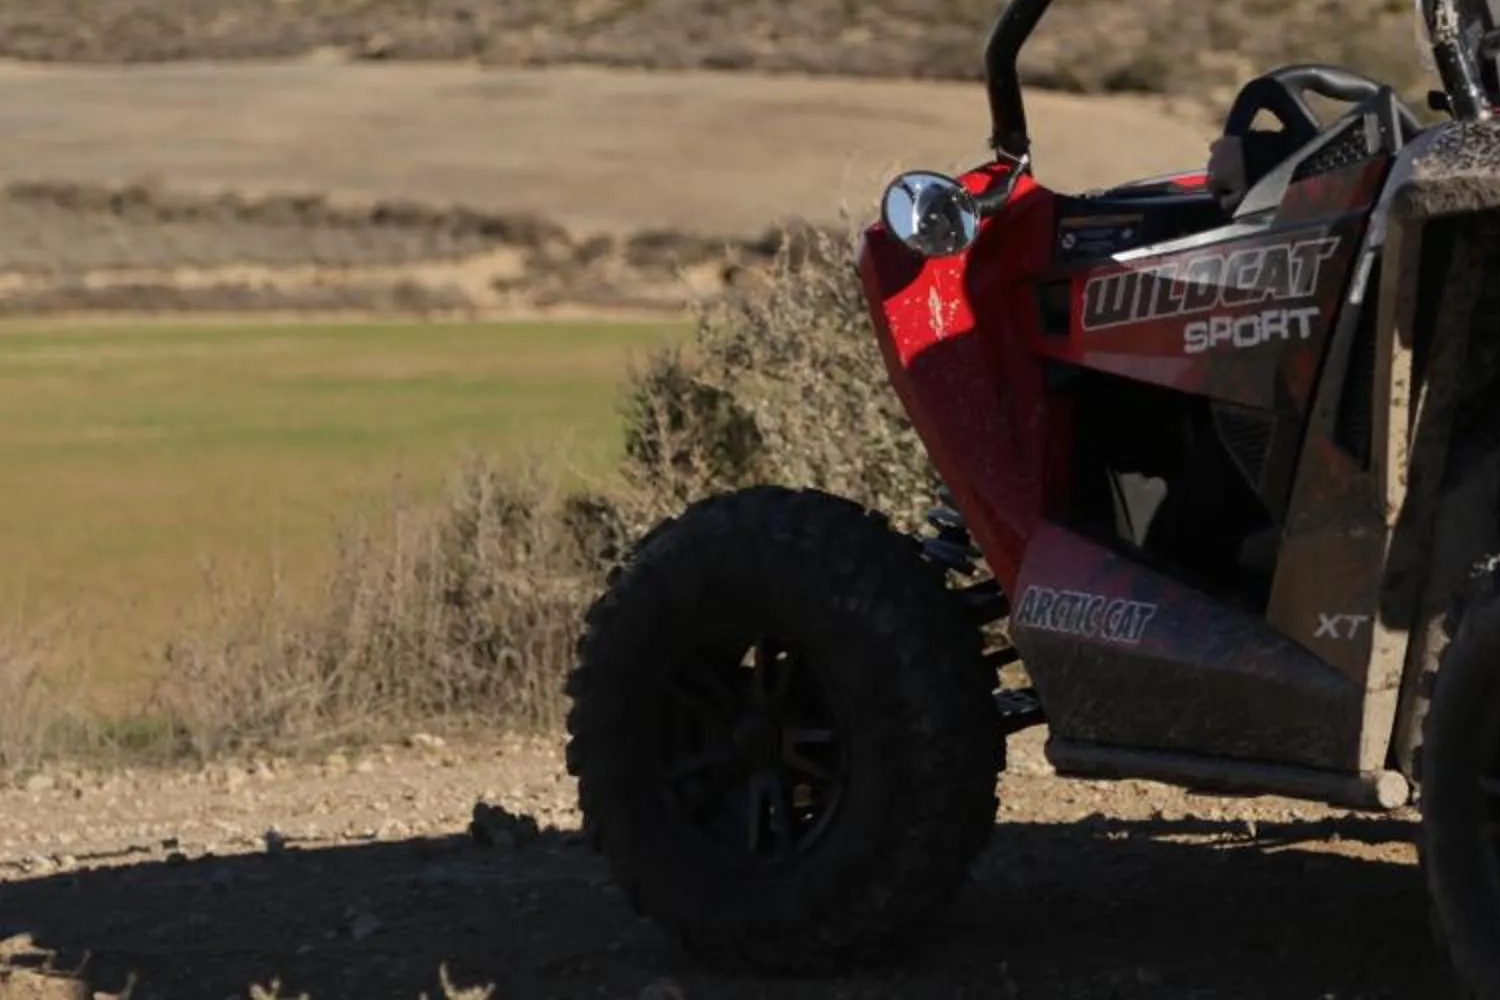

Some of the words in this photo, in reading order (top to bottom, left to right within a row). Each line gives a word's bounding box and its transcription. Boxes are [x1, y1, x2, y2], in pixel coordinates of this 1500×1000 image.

[1082, 237, 1340, 331] WILDCAT
[1183, 307, 1320, 353] SPORT
[1016, 585, 1105, 638] ARCTIC
[1099, 597, 1158, 644] CAT
[1313, 613, 1370, 640] XT
